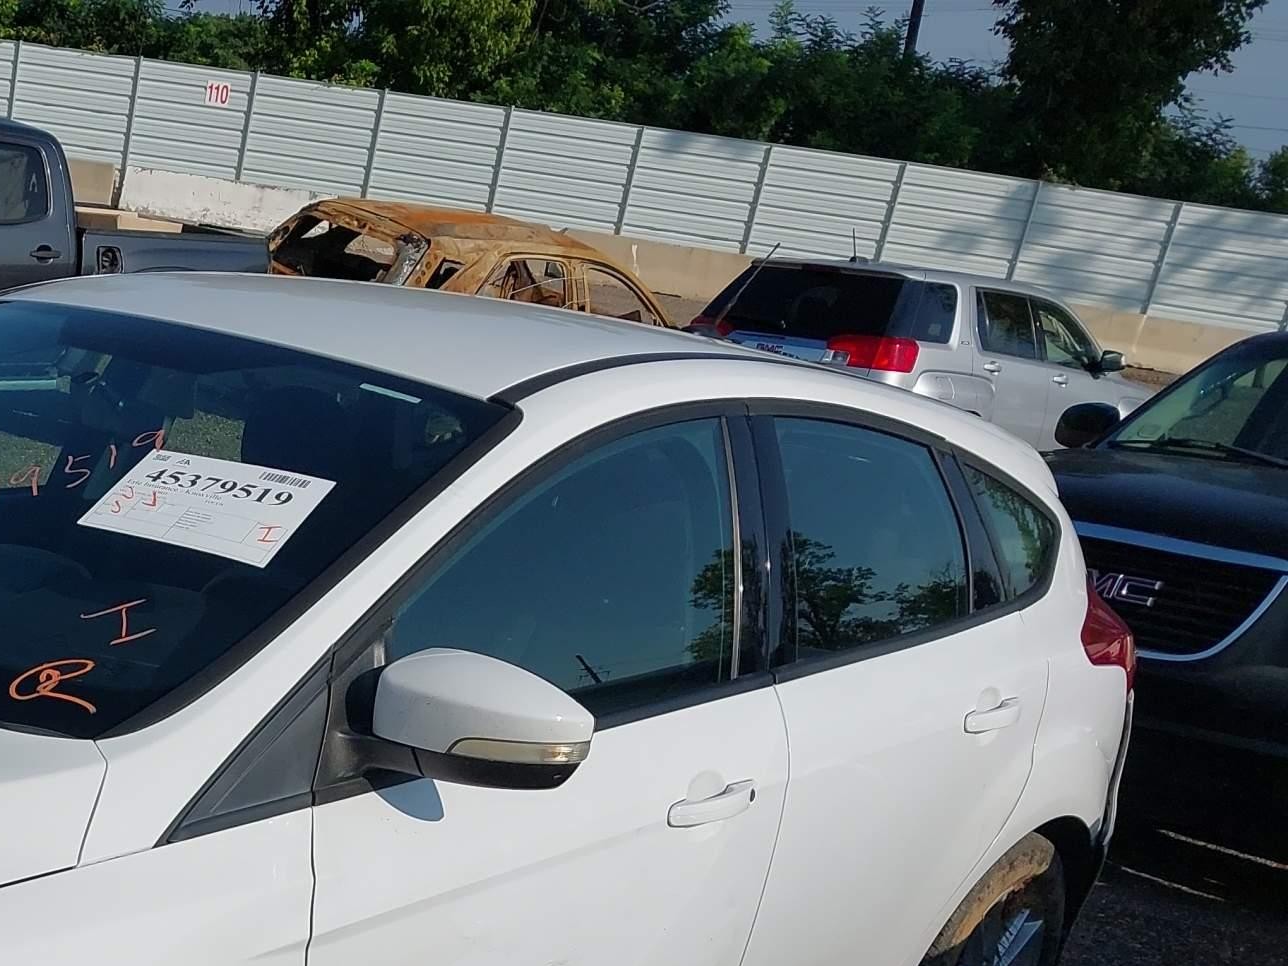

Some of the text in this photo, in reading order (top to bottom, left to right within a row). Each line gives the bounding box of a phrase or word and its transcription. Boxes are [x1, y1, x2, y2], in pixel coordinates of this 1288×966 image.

[207, 83, 230, 105] 110
[144, 467, 294, 506] 45379519
[1087, 568, 1165, 608] MC
